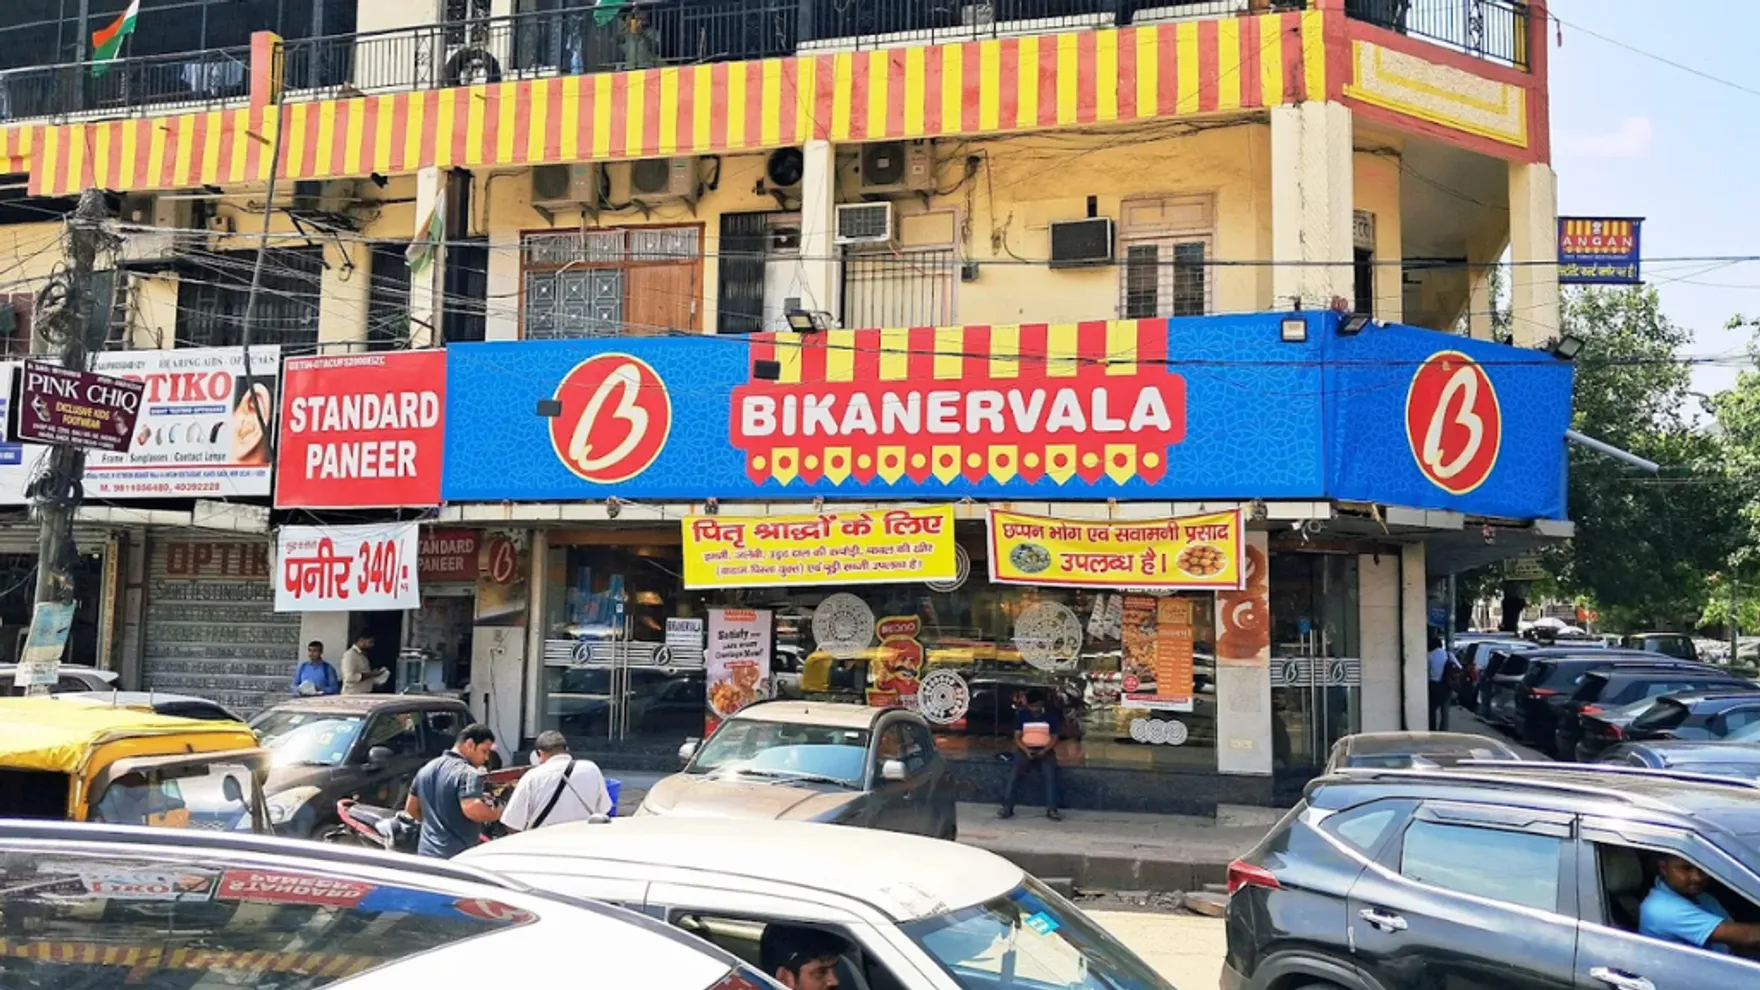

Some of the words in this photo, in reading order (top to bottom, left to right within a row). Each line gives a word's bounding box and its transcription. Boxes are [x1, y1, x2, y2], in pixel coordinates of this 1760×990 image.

[1562, 236, 1633, 247] ANGAN
[27, 372, 80, 399] PINK
[86, 384, 138, 414] CHIQ
[121, 371, 232, 403] TIKO
[55, 401, 94, 417] EXCLUSIVE
[93, 408, 110, 421] KIDS
[62, 414, 101, 429] FOOTWEAR
[289, 391, 439, 433] STANDARD
[742, 386, 1172, 437] BIKANERVALA
[102, 454, 124, 463] Frame
[130, 452, 168, 463] Sunglasses
[174, 452, 202, 462] Contact
[306, 440, 417, 479] PANEER
[692, 518, 746, 548] पितृ
[753, 514, 837, 541] श्राद्धों
[841, 514, 873, 537] के
[883, 510, 943, 535] लिए
[1003, 522, 1044, 540] छप्पन
[1049, 521, 1081, 541] भोग
[1086, 523, 1112, 542] एवं
[1115, 520, 1179, 541] सवामनी
[1184, 523, 1229, 543] प्रसाद
[419, 538, 475, 554] ANDARD
[813, 545, 827, 557] की
[285, 537, 353, 599] पनीर
[1060, 553, 1134, 573] उपलब्ध
